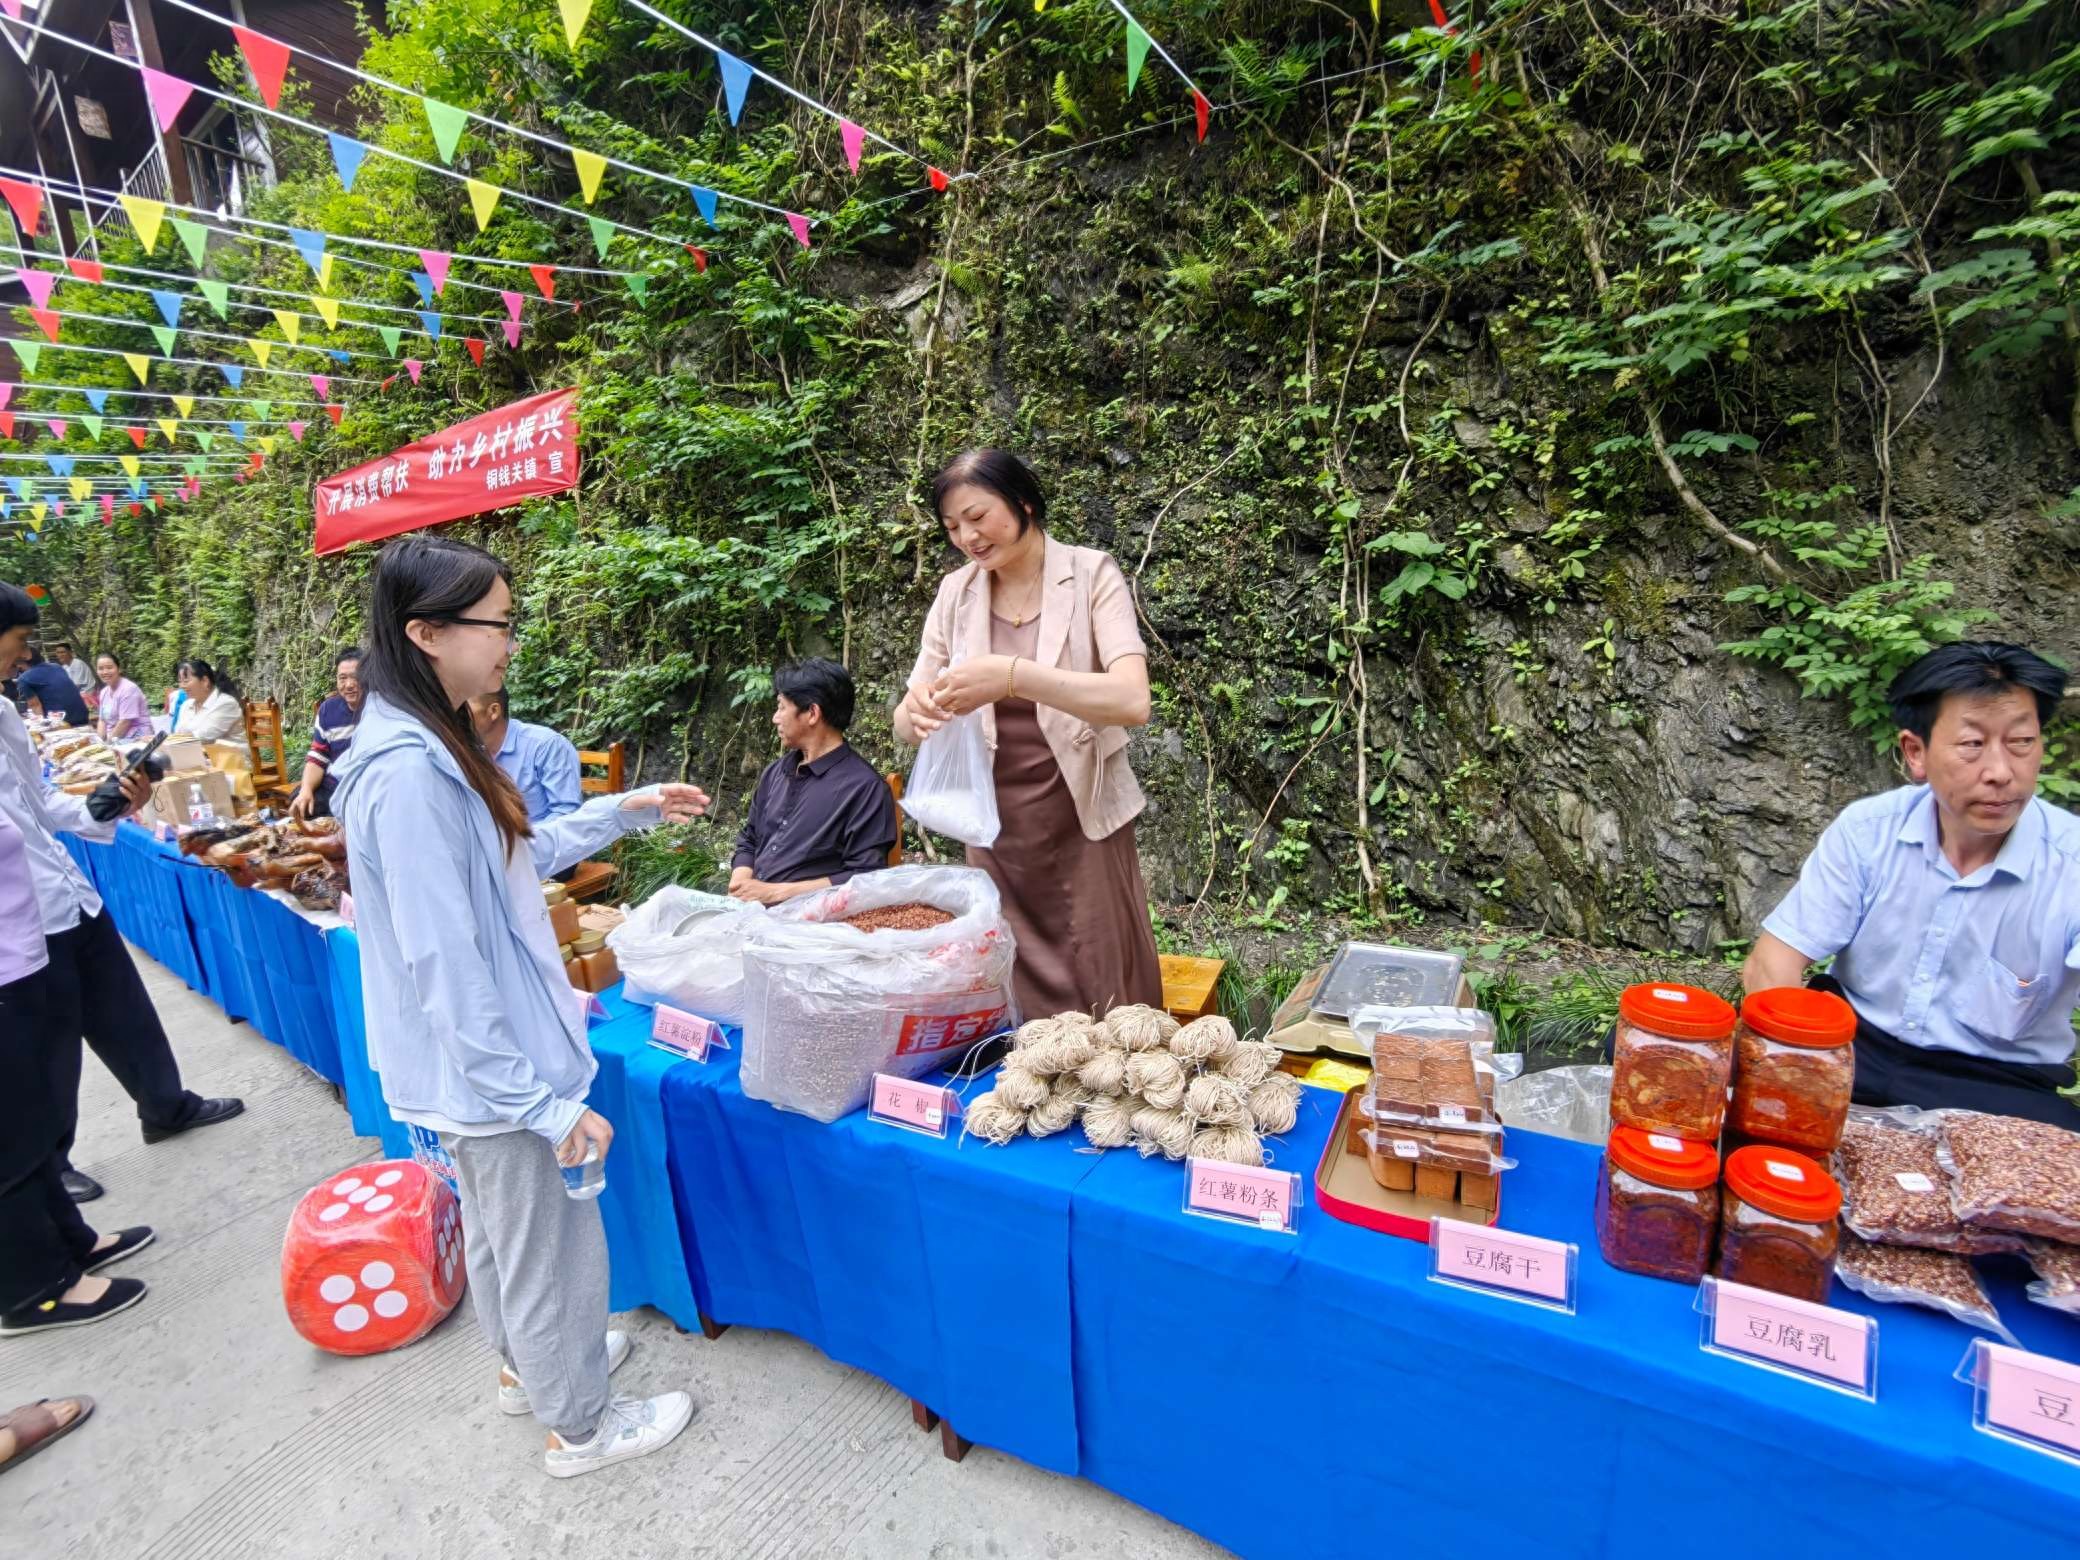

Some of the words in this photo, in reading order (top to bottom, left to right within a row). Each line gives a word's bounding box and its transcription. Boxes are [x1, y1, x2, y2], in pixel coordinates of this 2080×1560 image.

[326, 459, 410, 516] 开展消费帮扶
[427, 405, 564, 481] 助力乡村振兴
[486, 457, 537, 491] 铜钱关镇
[1199, 1177, 1279, 1209] 红薯粉条
[1463, 1245, 1541, 1280] 豆腐干
[1744, 1315, 1836, 1362] 豆腐乳
[2031, 1388, 2074, 1425] 豆
